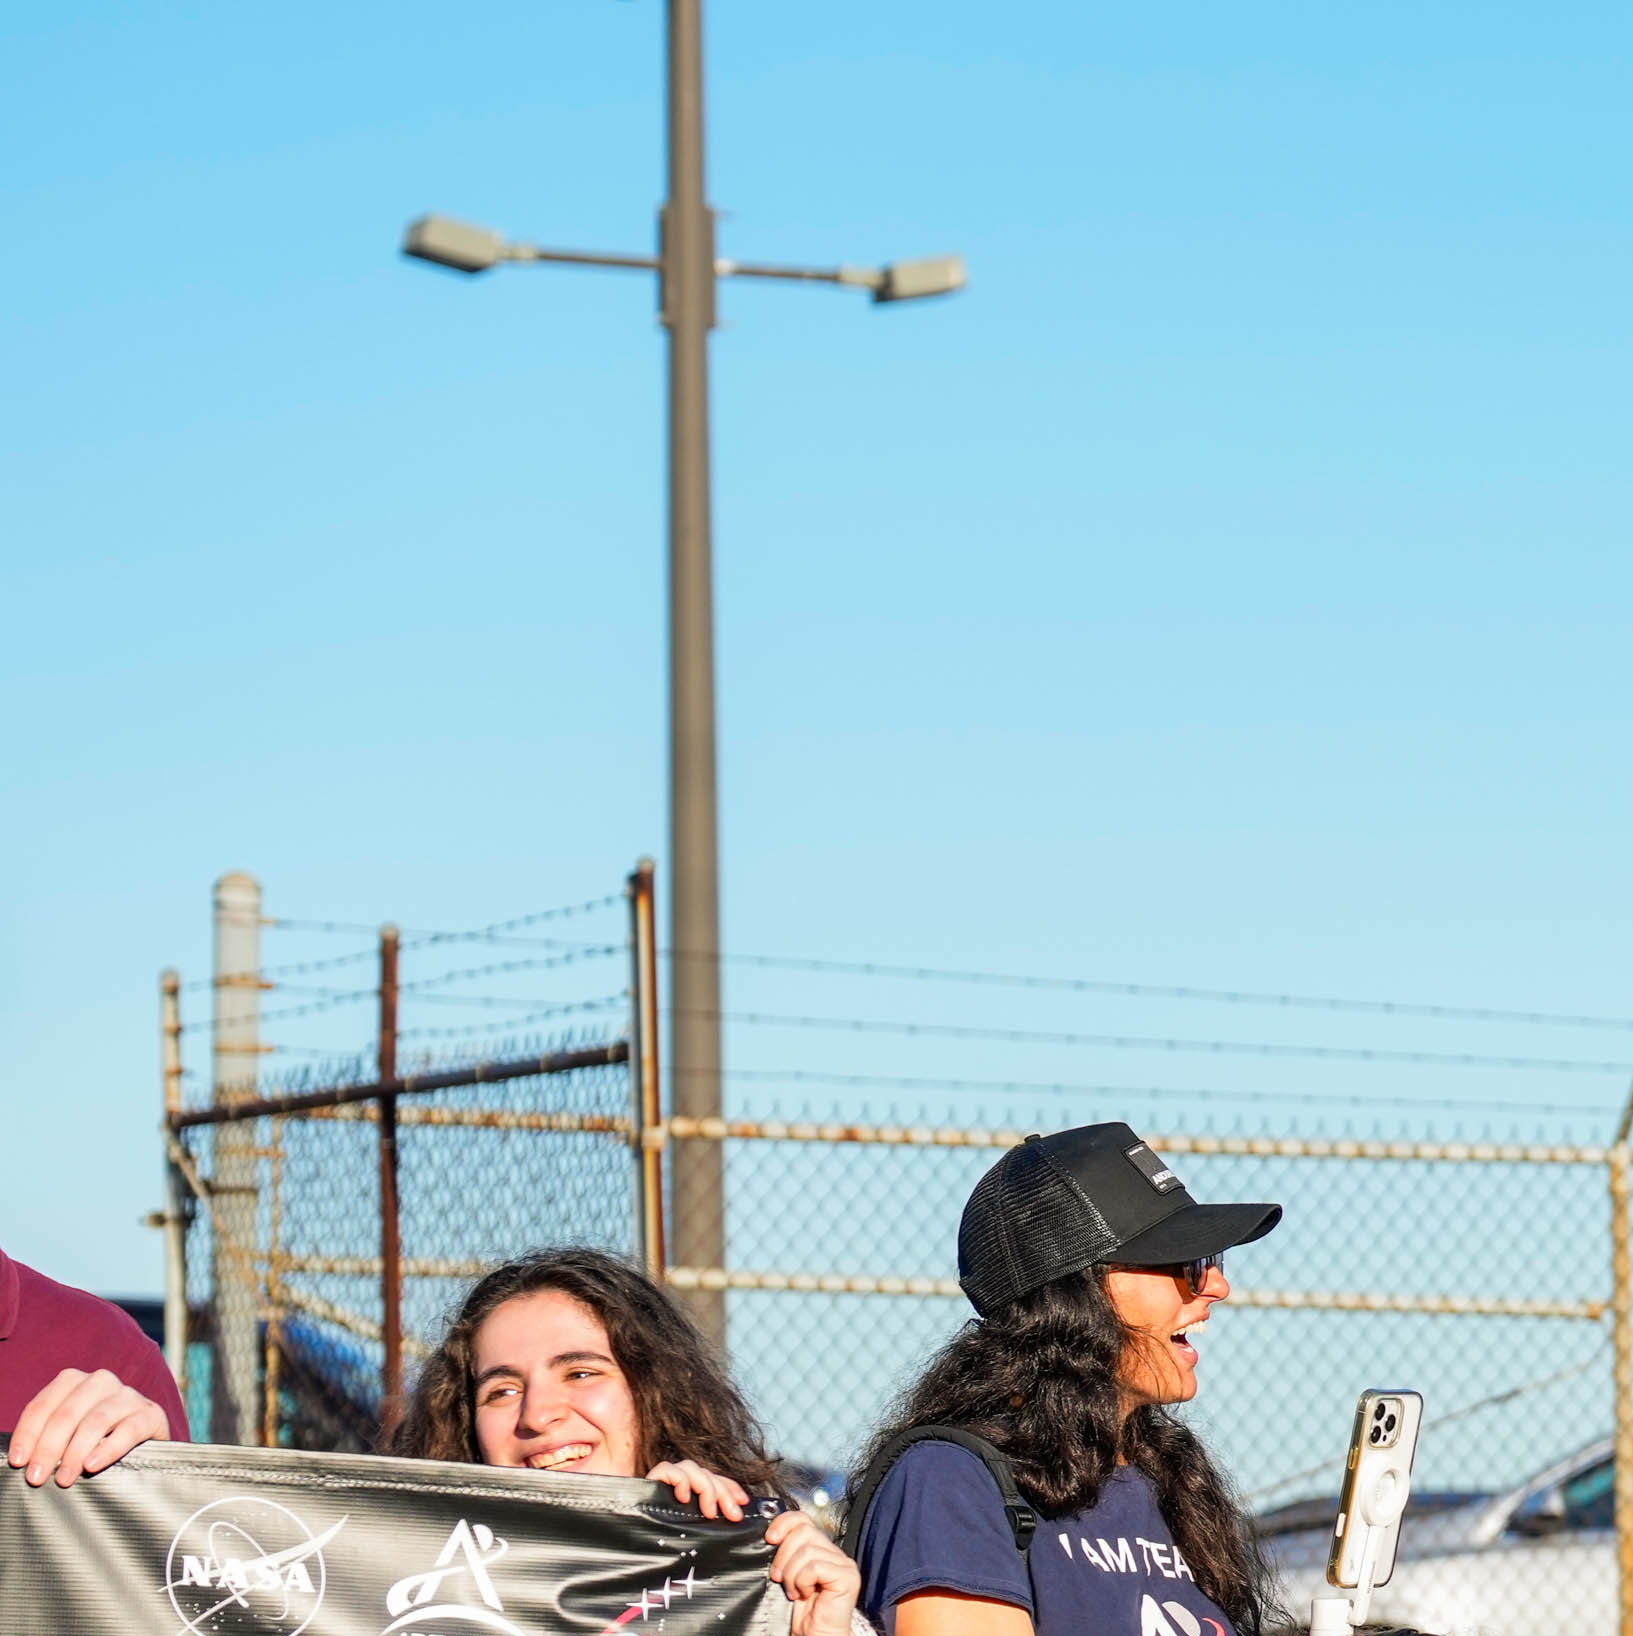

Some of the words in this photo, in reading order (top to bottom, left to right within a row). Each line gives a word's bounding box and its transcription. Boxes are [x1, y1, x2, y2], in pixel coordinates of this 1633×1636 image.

[181, 1554, 315, 1593] NASA
[1081, 1537, 1138, 1574] AM
[1136, 1537, 1197, 1583] TEA
